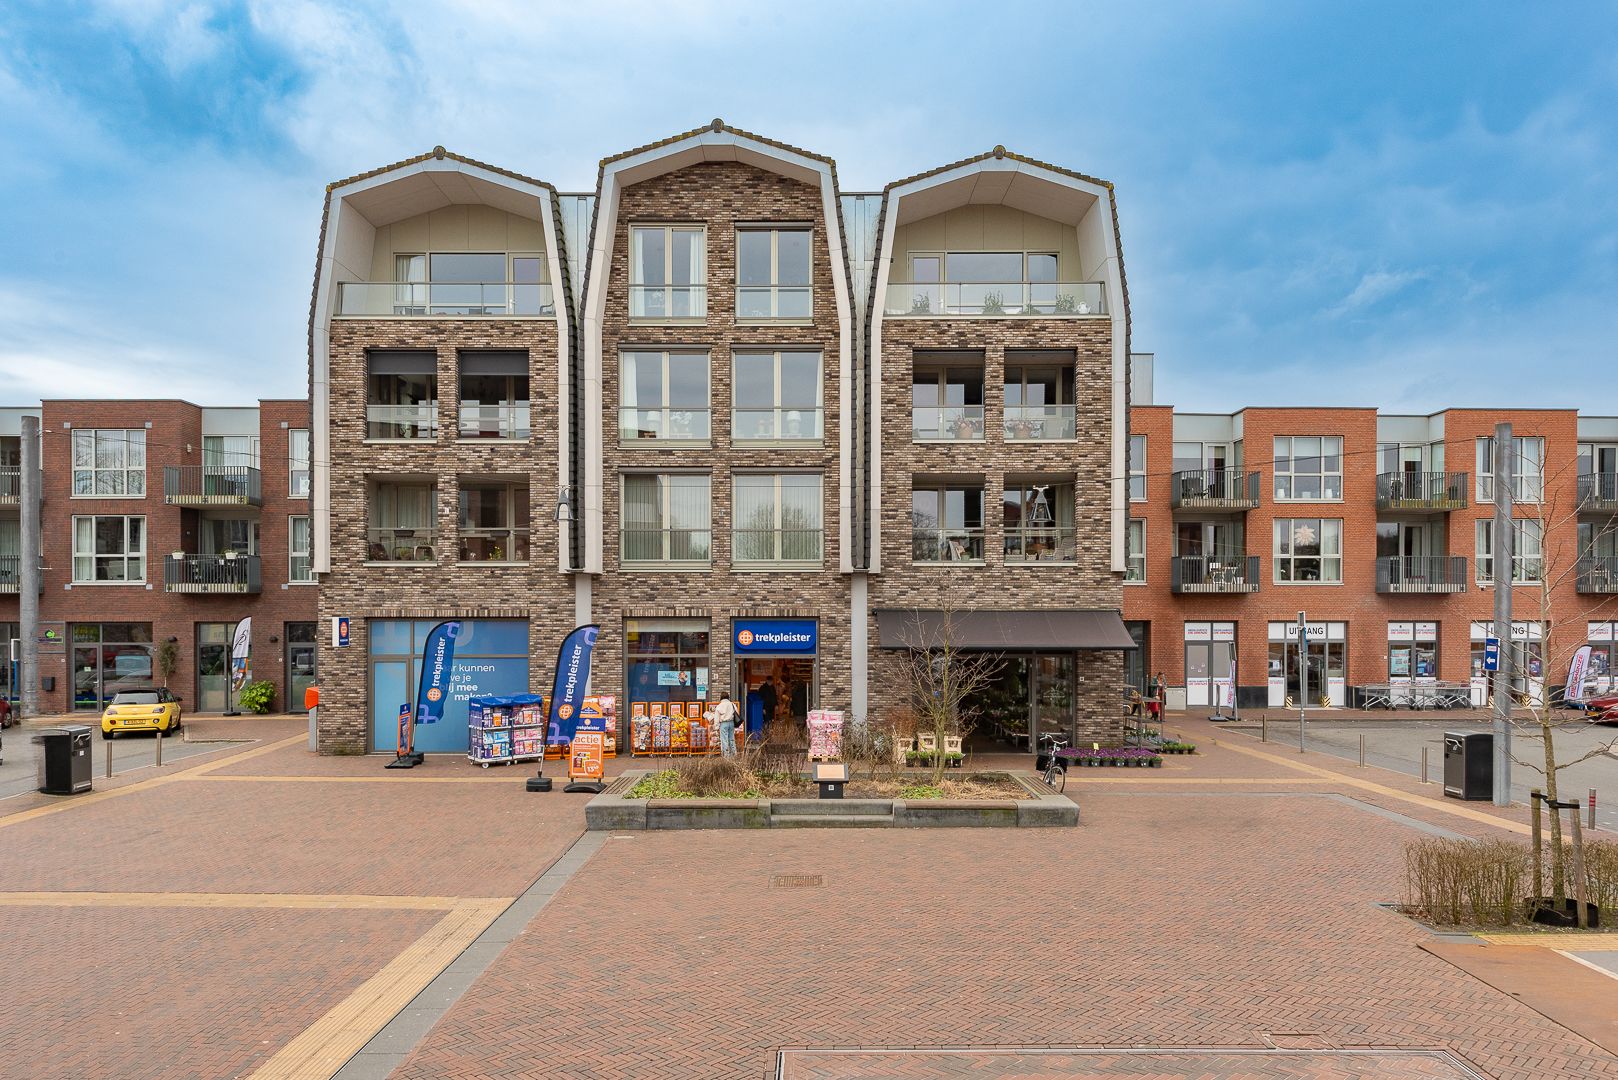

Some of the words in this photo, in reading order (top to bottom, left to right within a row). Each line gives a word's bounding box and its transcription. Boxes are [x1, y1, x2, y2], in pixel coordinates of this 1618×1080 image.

[1289, 627, 1324, 635] UIANG
[755, 632, 811, 644] trekpleister
[432, 636, 446, 687] trekpleister
[462, 674, 471, 683] je
[564, 644, 582, 703] trekpleister
[574, 735, 598, 743] actie
